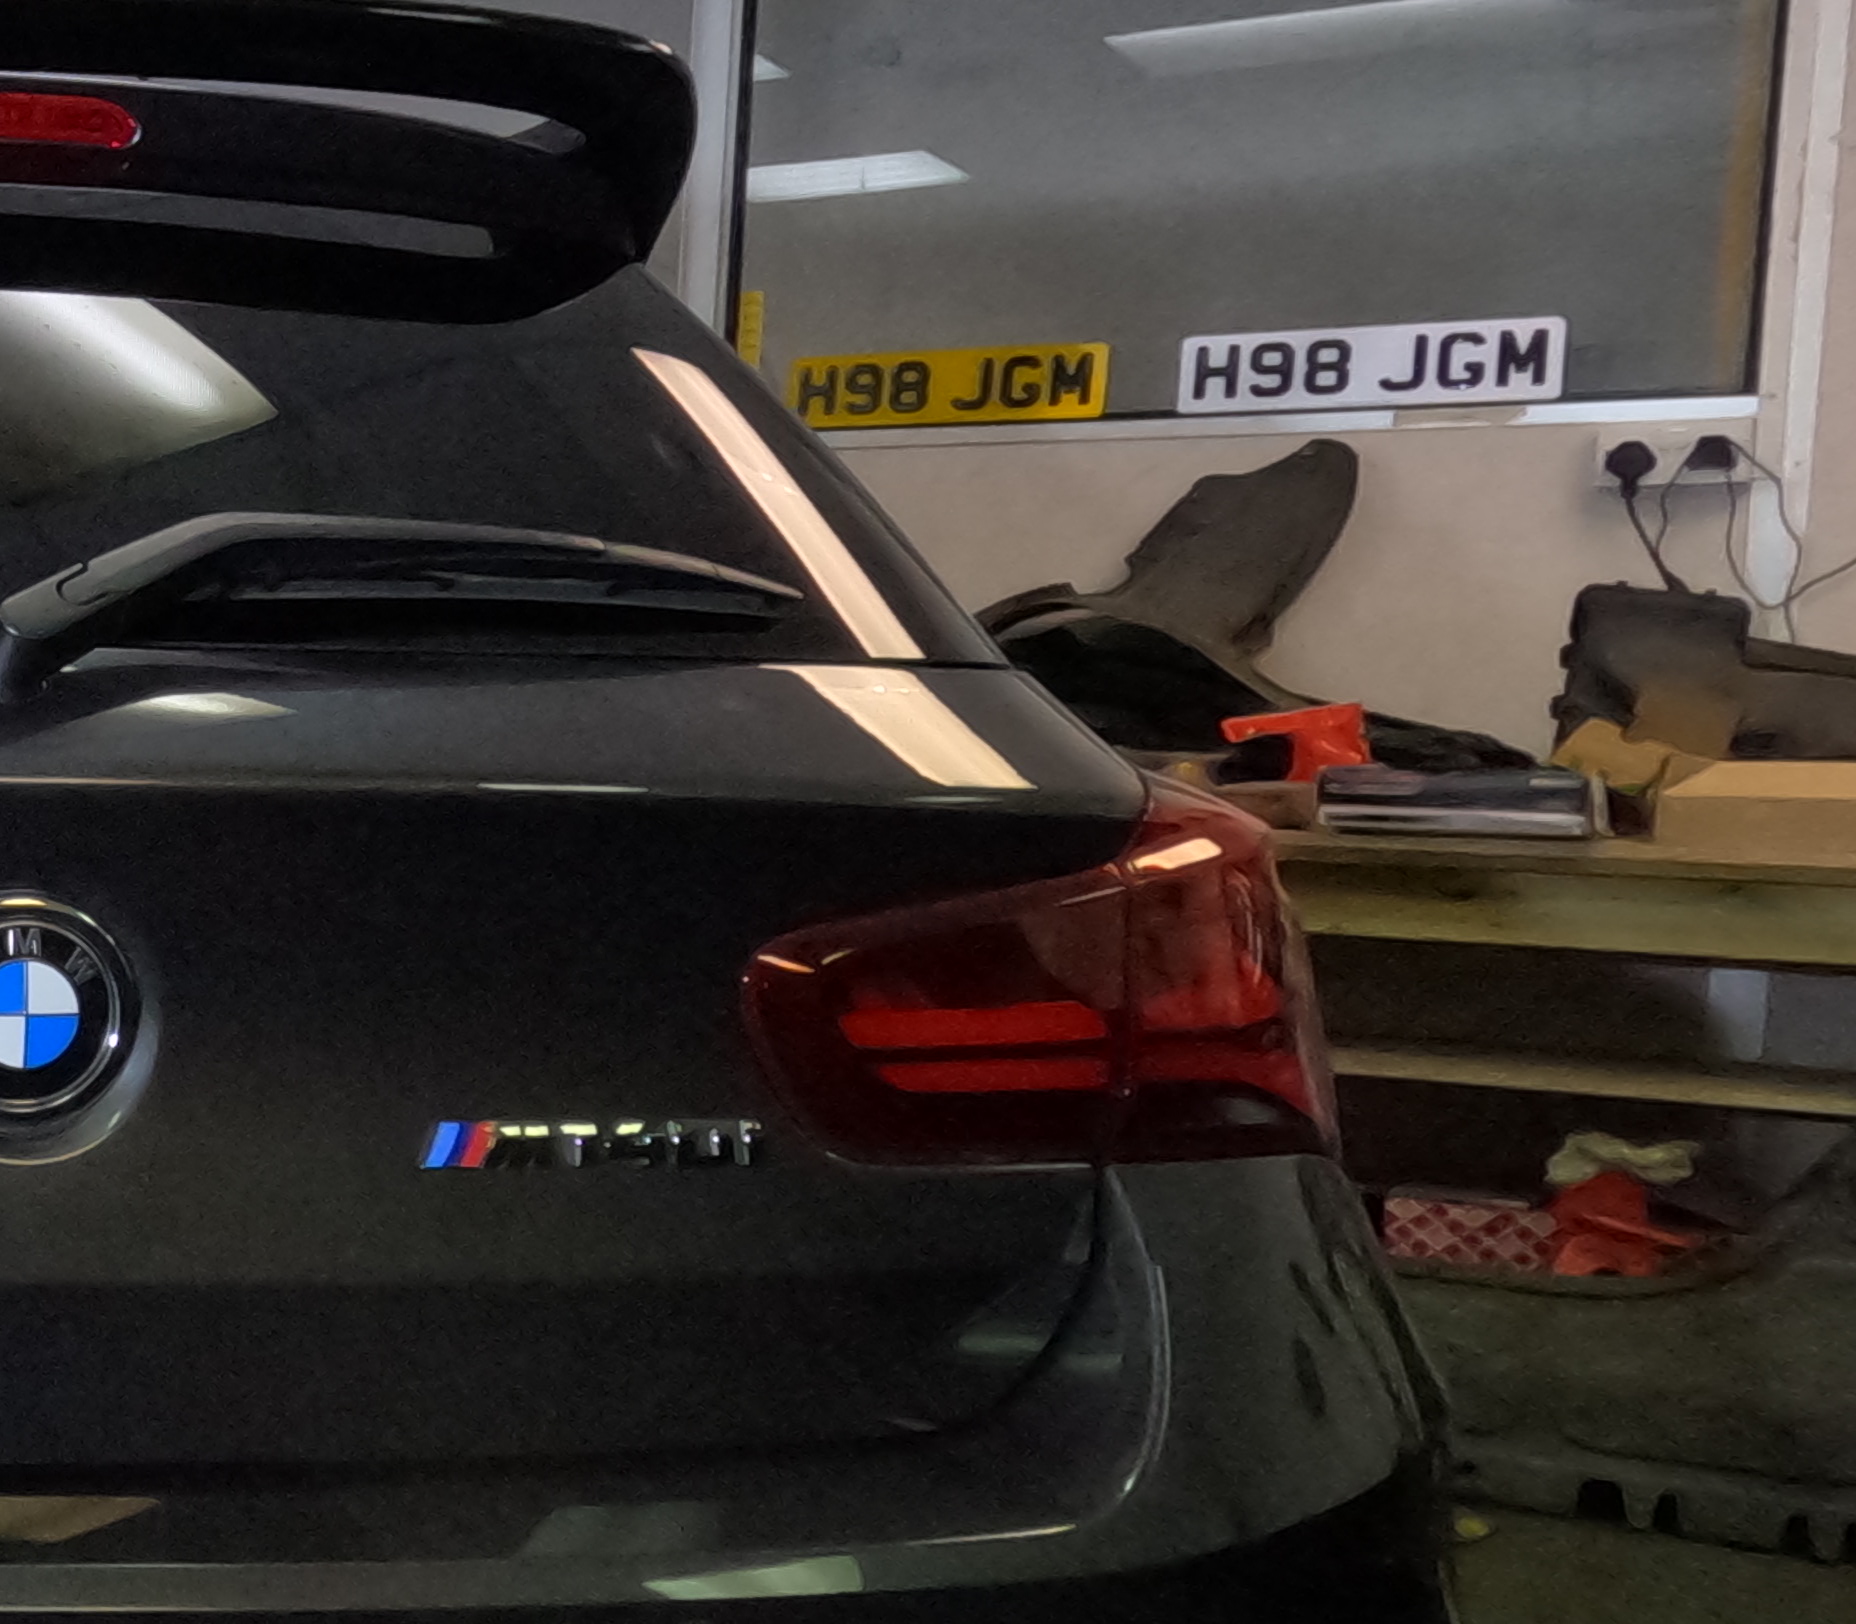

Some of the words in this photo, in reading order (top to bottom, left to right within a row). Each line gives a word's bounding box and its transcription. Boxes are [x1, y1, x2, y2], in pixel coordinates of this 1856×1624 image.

[796, 359, 931, 417] H98
[950, 351, 1095, 413] JGM
[1191, 338, 1353, 400] H98
[1378, 327, 1551, 392] JGM
